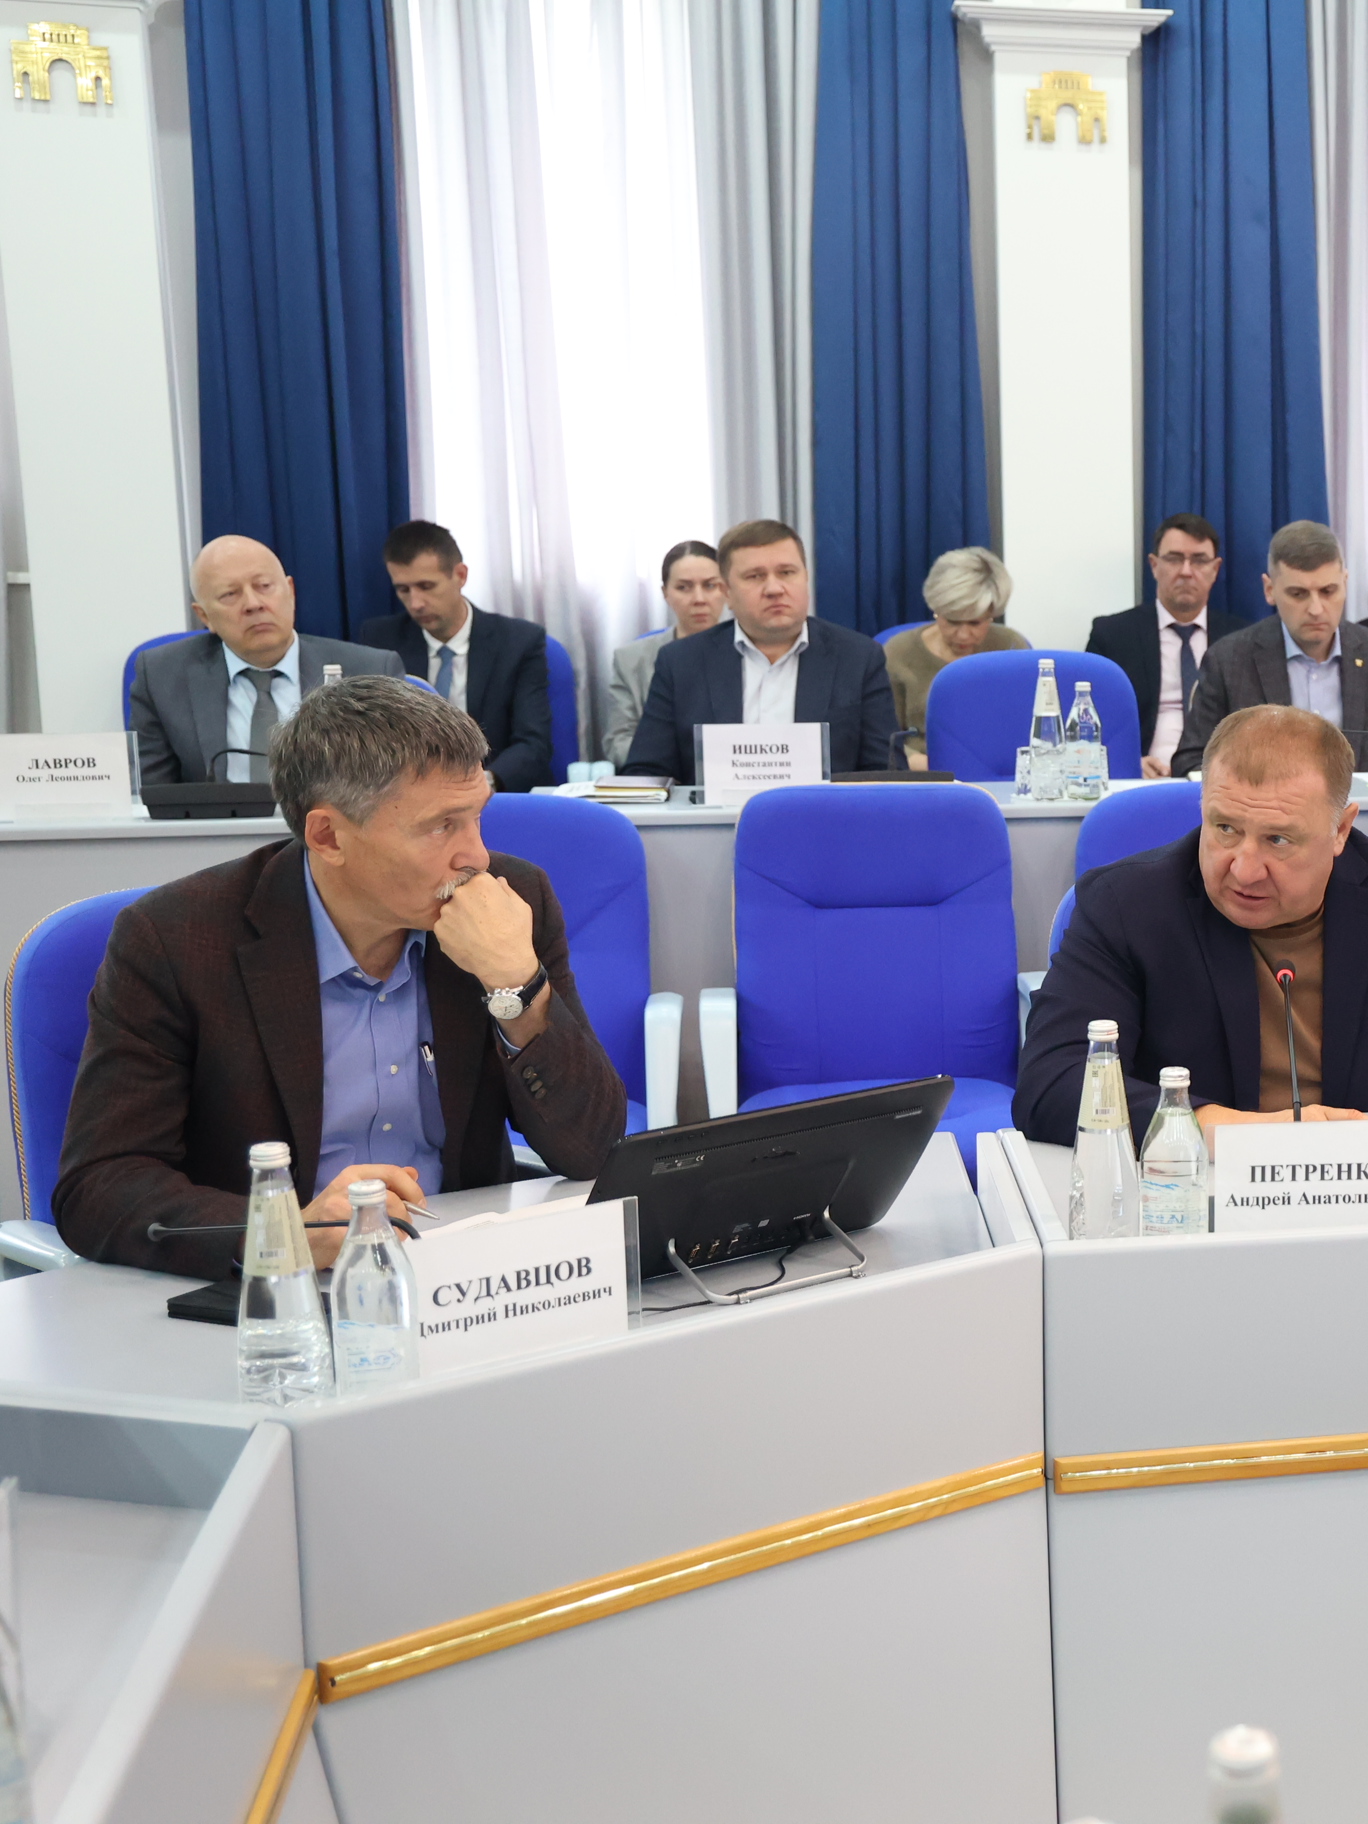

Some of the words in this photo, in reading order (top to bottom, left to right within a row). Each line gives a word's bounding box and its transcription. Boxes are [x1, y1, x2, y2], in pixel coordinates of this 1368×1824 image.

[732, 743, 790, 755] ИШКОВ
[28, 757, 97, 770] ЛАВРОВ
[731, 759, 792, 768] Константин
[16, 774, 43, 783] Олег
[46, 773, 111, 783] Леонидович
[733, 773, 791, 781] Алексеевич
[1225, 1191, 1292, 1210] Андрей
[432, 1256, 593, 1307] СУДАВЦОВ
[503, 1285, 613, 1319] Николаевич
